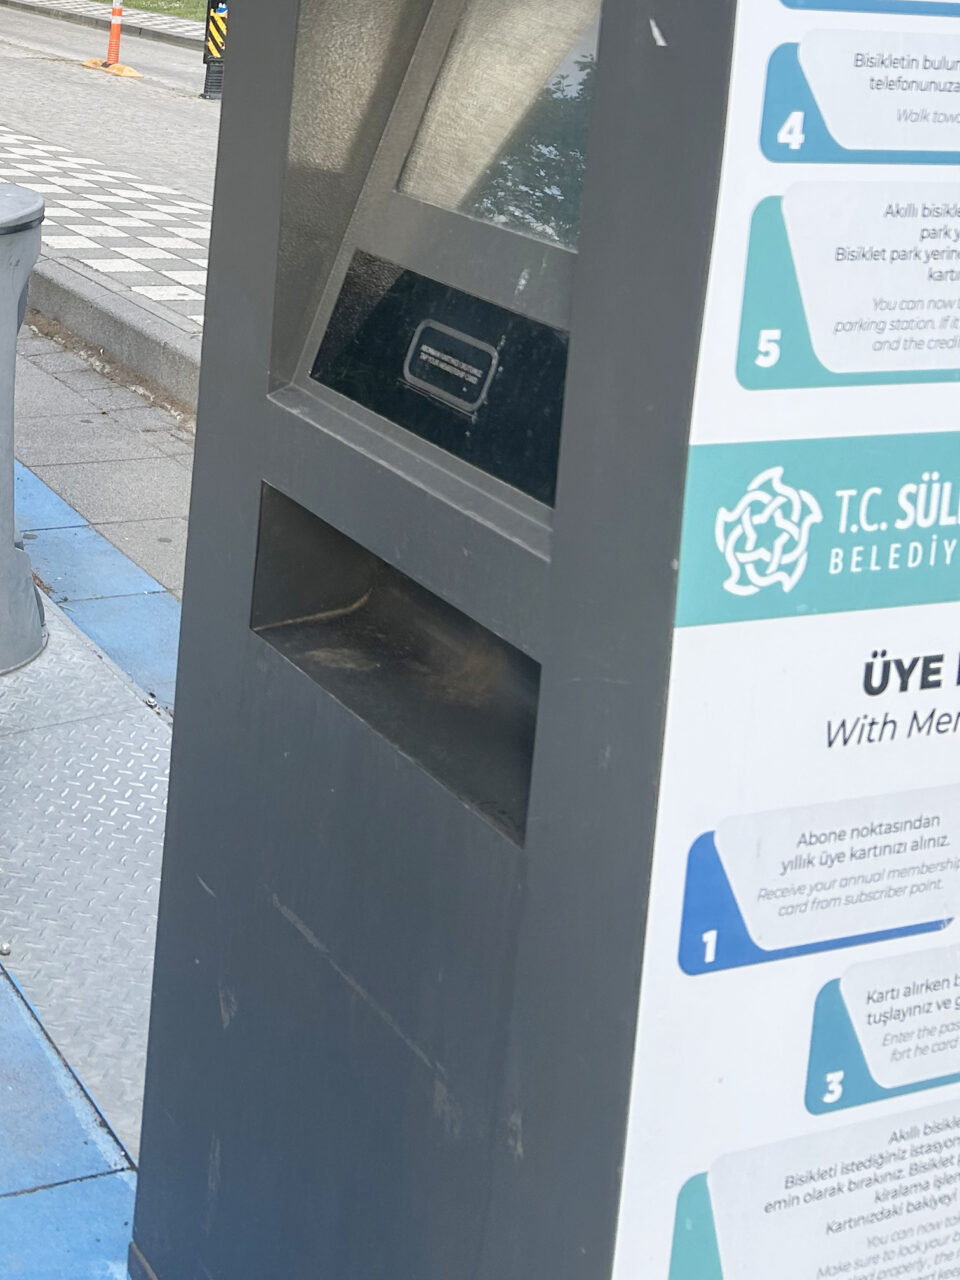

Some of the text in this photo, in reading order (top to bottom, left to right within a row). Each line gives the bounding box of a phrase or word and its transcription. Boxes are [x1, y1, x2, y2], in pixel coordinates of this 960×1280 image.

[854, 52, 920, 69] Bisikletin
[777, 110, 806, 150] 4
[920, 225, 951, 242] park
[835, 246, 887, 261] Bisiklet
[890, 246, 921, 263] park
[754, 329, 782, 368] 5
[835, 471, 960, 533] T.C. SÜL
[829, 534, 957, 574] BELEDİY
[863, 649, 944, 696] ÜYE
[827, 712, 897, 748] With
[796, 814, 940, 848] Abone noktasından
[779, 855, 815, 876] yıllık
[819, 850, 846, 869] üye
[849, 841, 908, 862] kartınızı
[757, 884, 807, 902] Receive
[808, 880, 837, 898] your
[839, 869, 885, 889] annual
[778, 901, 809, 917] card
[811, 897, 841, 912] from
[843, 884, 908, 906] subscriber
[701, 929, 717, 964] 1
[866, 988, 900, 1005] Kartı
[903, 978, 950, 998] alırken
[822, 1070, 844, 1104] 3
[764, 1194, 801, 1213] emin
